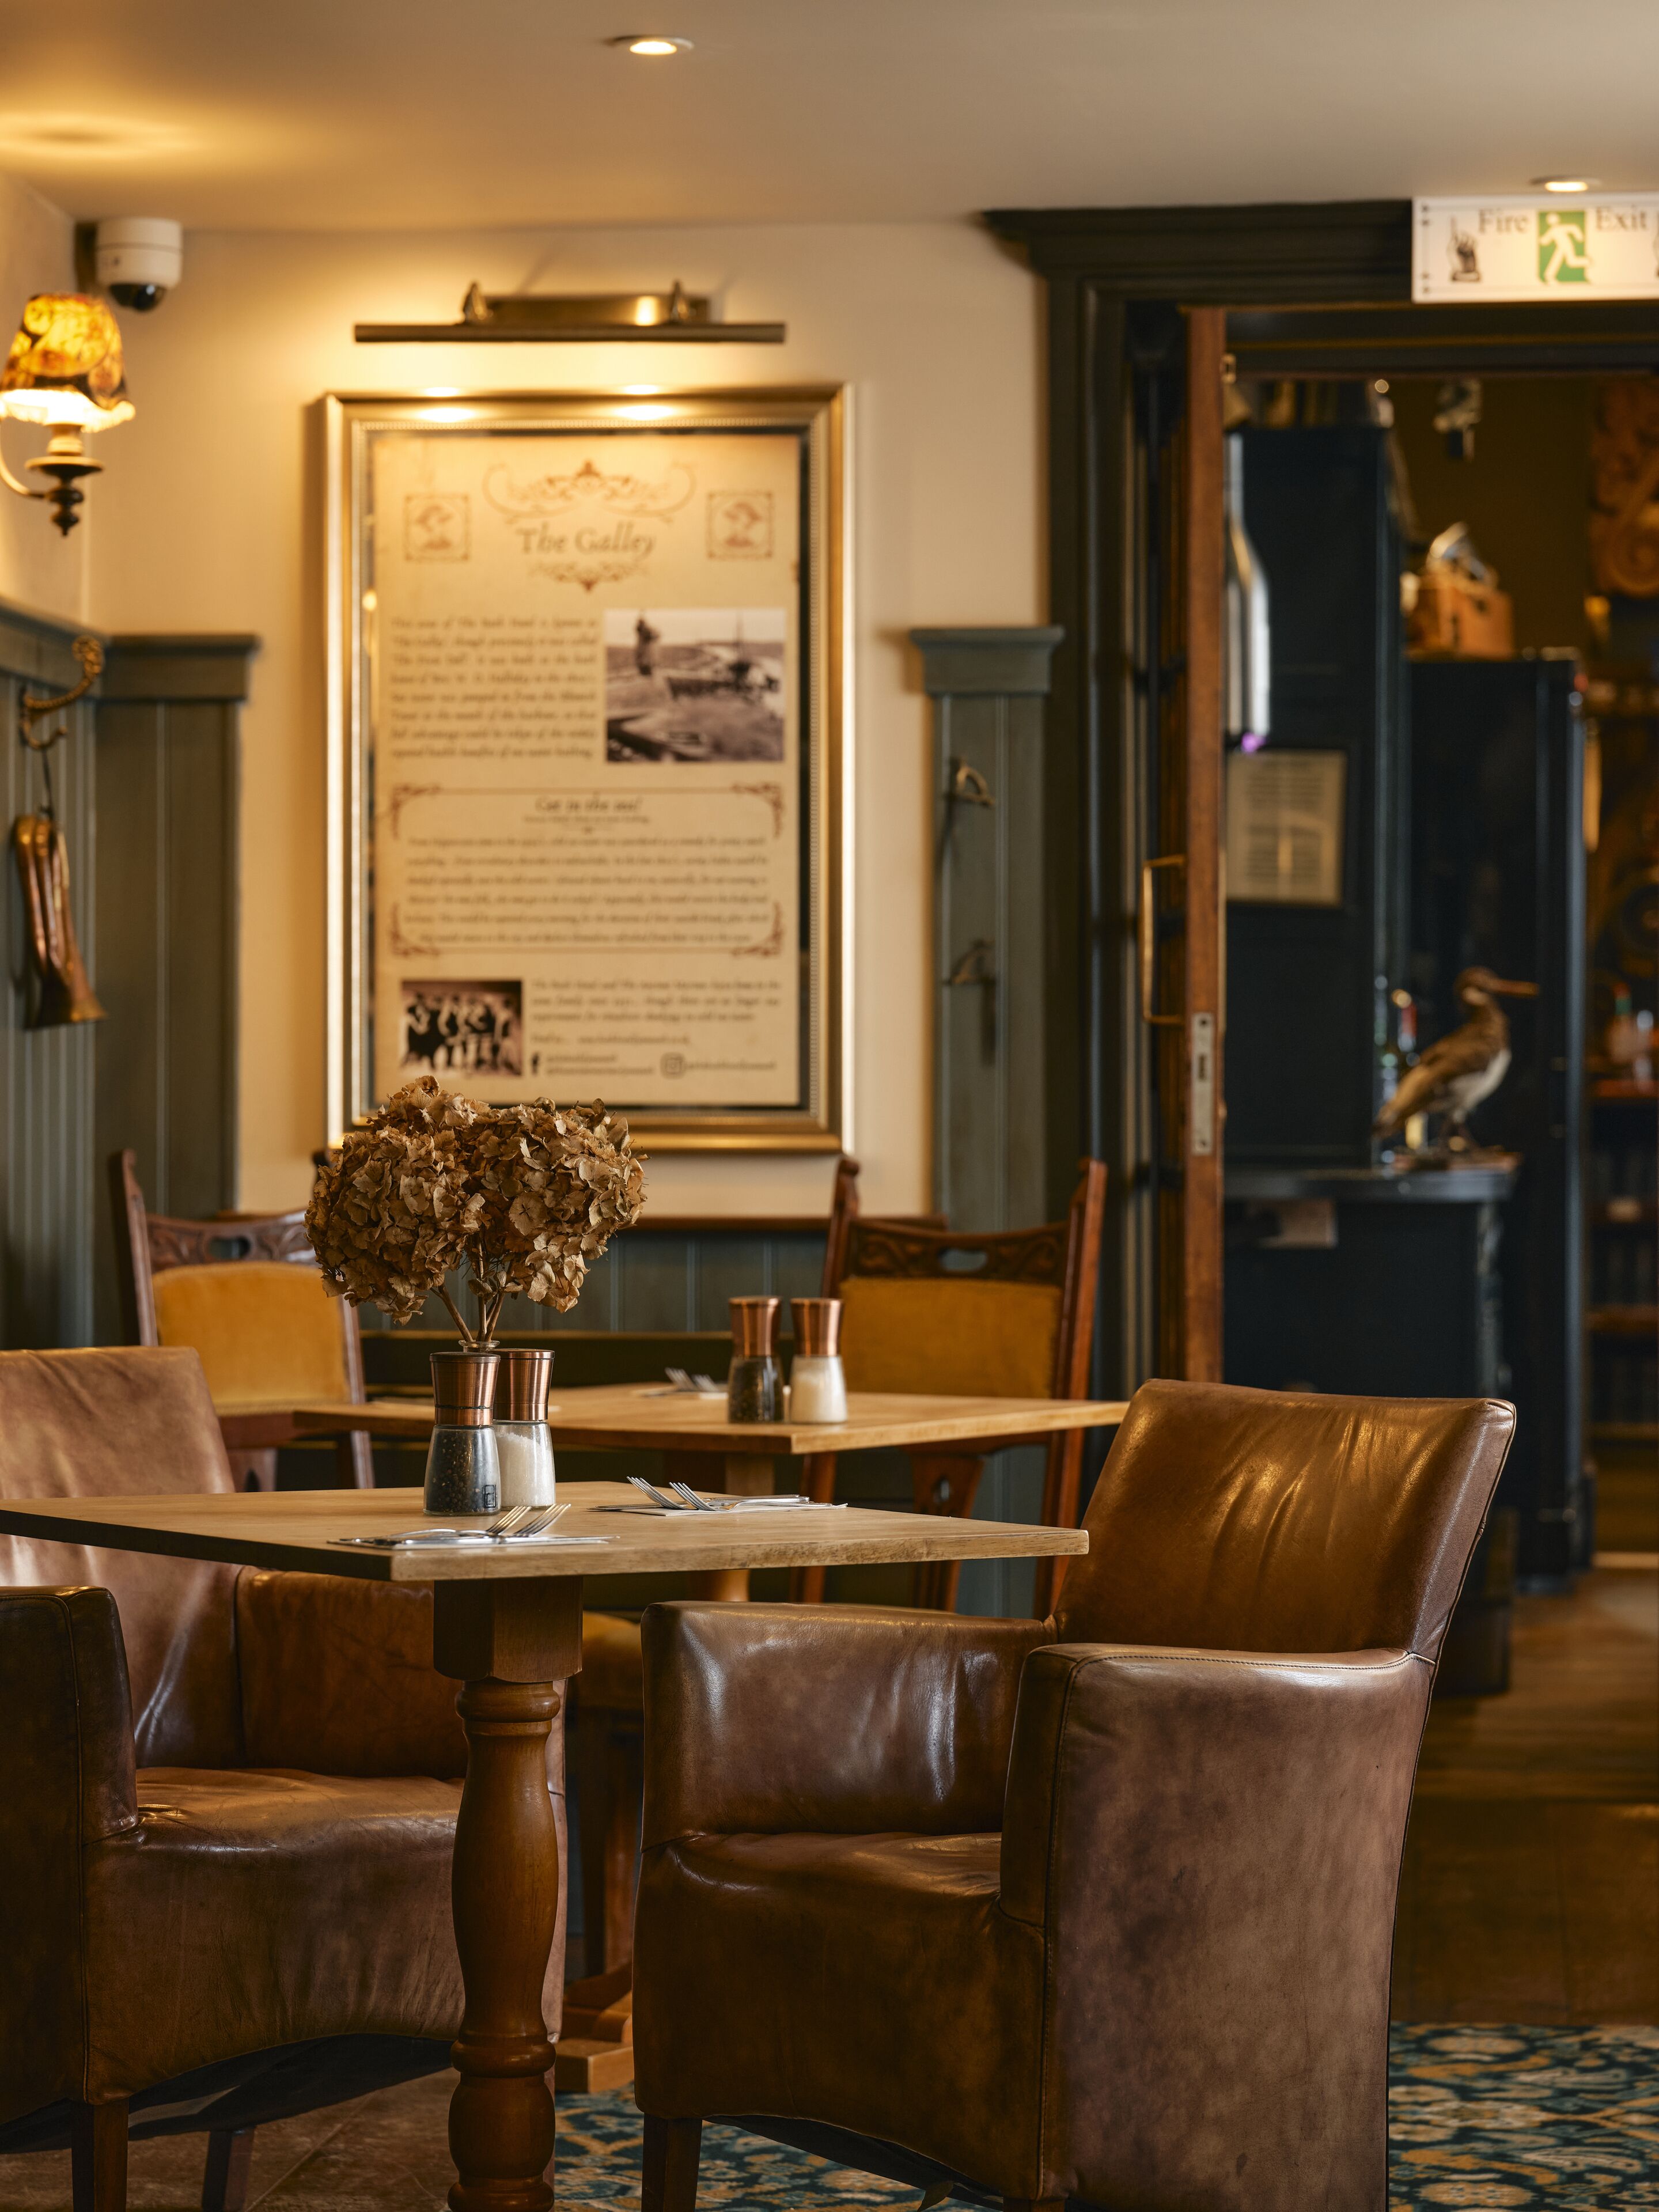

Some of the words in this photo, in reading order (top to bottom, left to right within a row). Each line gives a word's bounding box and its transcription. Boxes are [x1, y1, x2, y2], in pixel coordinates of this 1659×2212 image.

[1478, 208, 1529, 233] Fire
[1596, 205, 1647, 231] Exit
[516, 521, 567, 554] The
[575, 521, 656, 562] Galley
[584, 791, 609, 812] the
